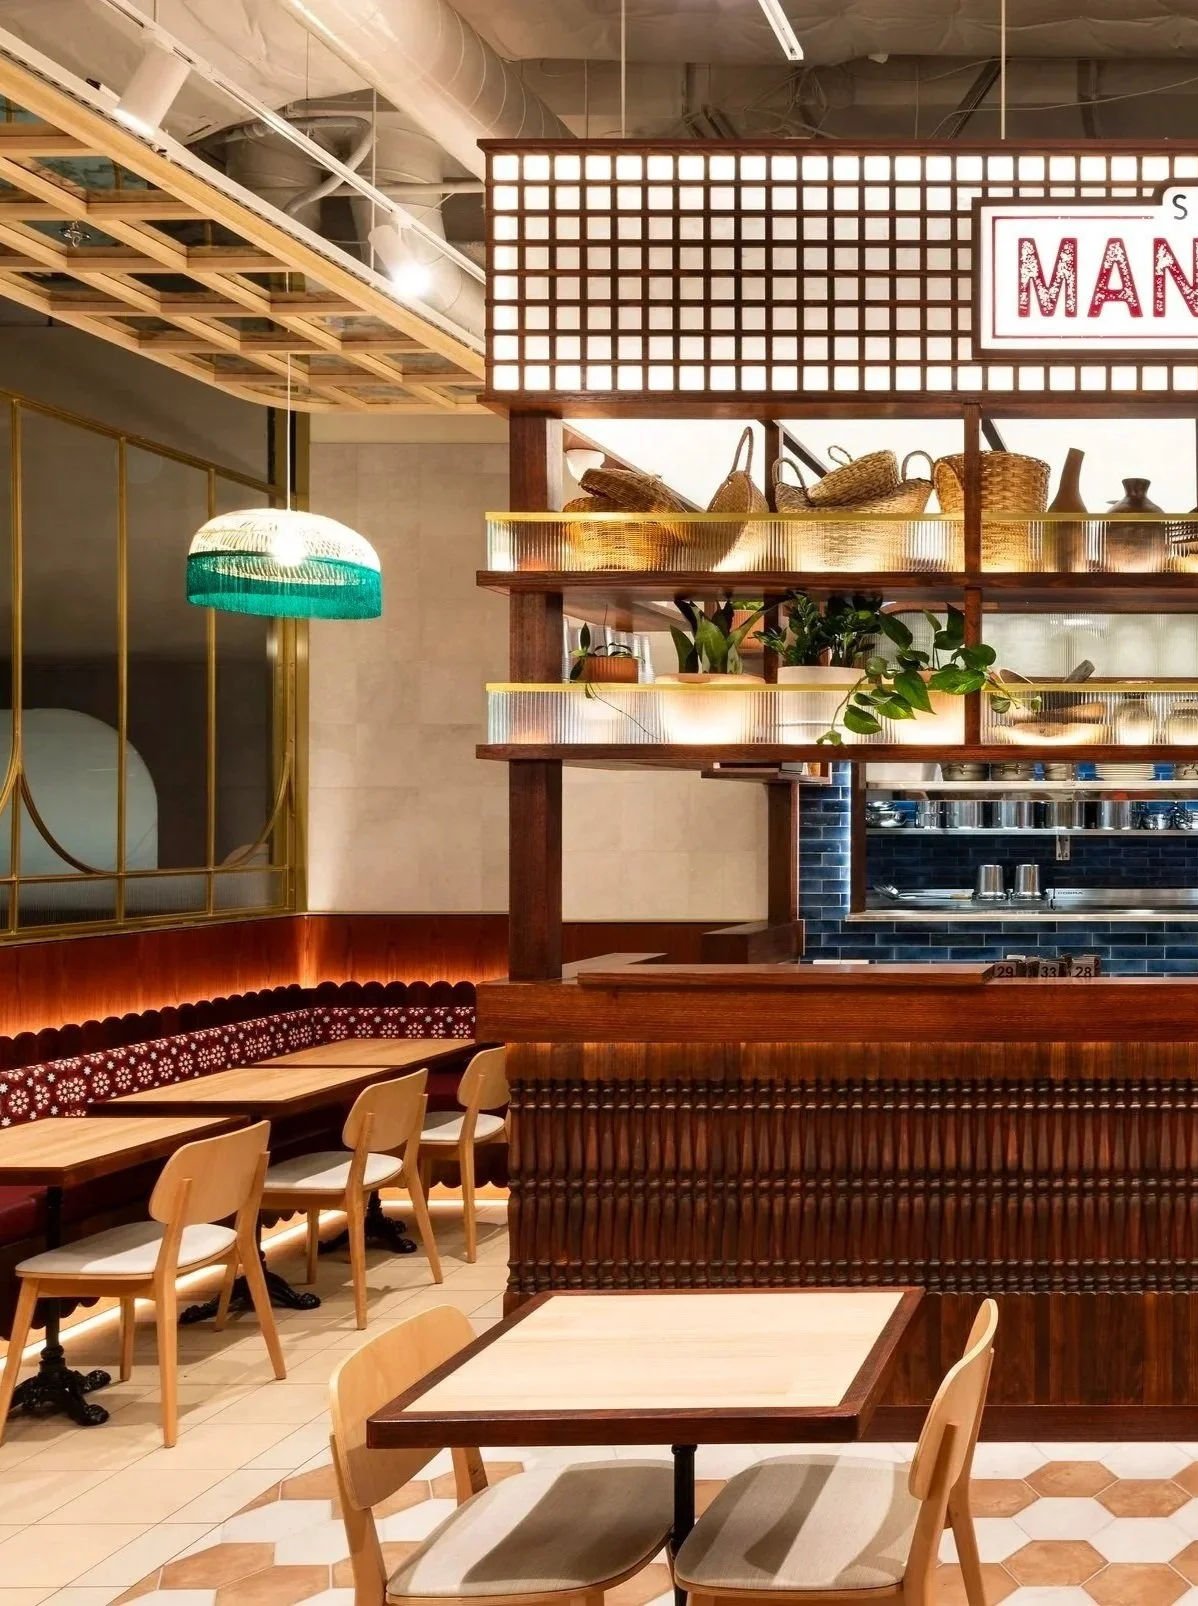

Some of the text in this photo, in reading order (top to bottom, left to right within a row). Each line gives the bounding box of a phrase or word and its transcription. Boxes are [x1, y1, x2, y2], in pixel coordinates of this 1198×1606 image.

[997, 966, 1014, 977] 29
[1041, 966, 1057, 977] 33
[1075, 966, 1092, 977] 28
